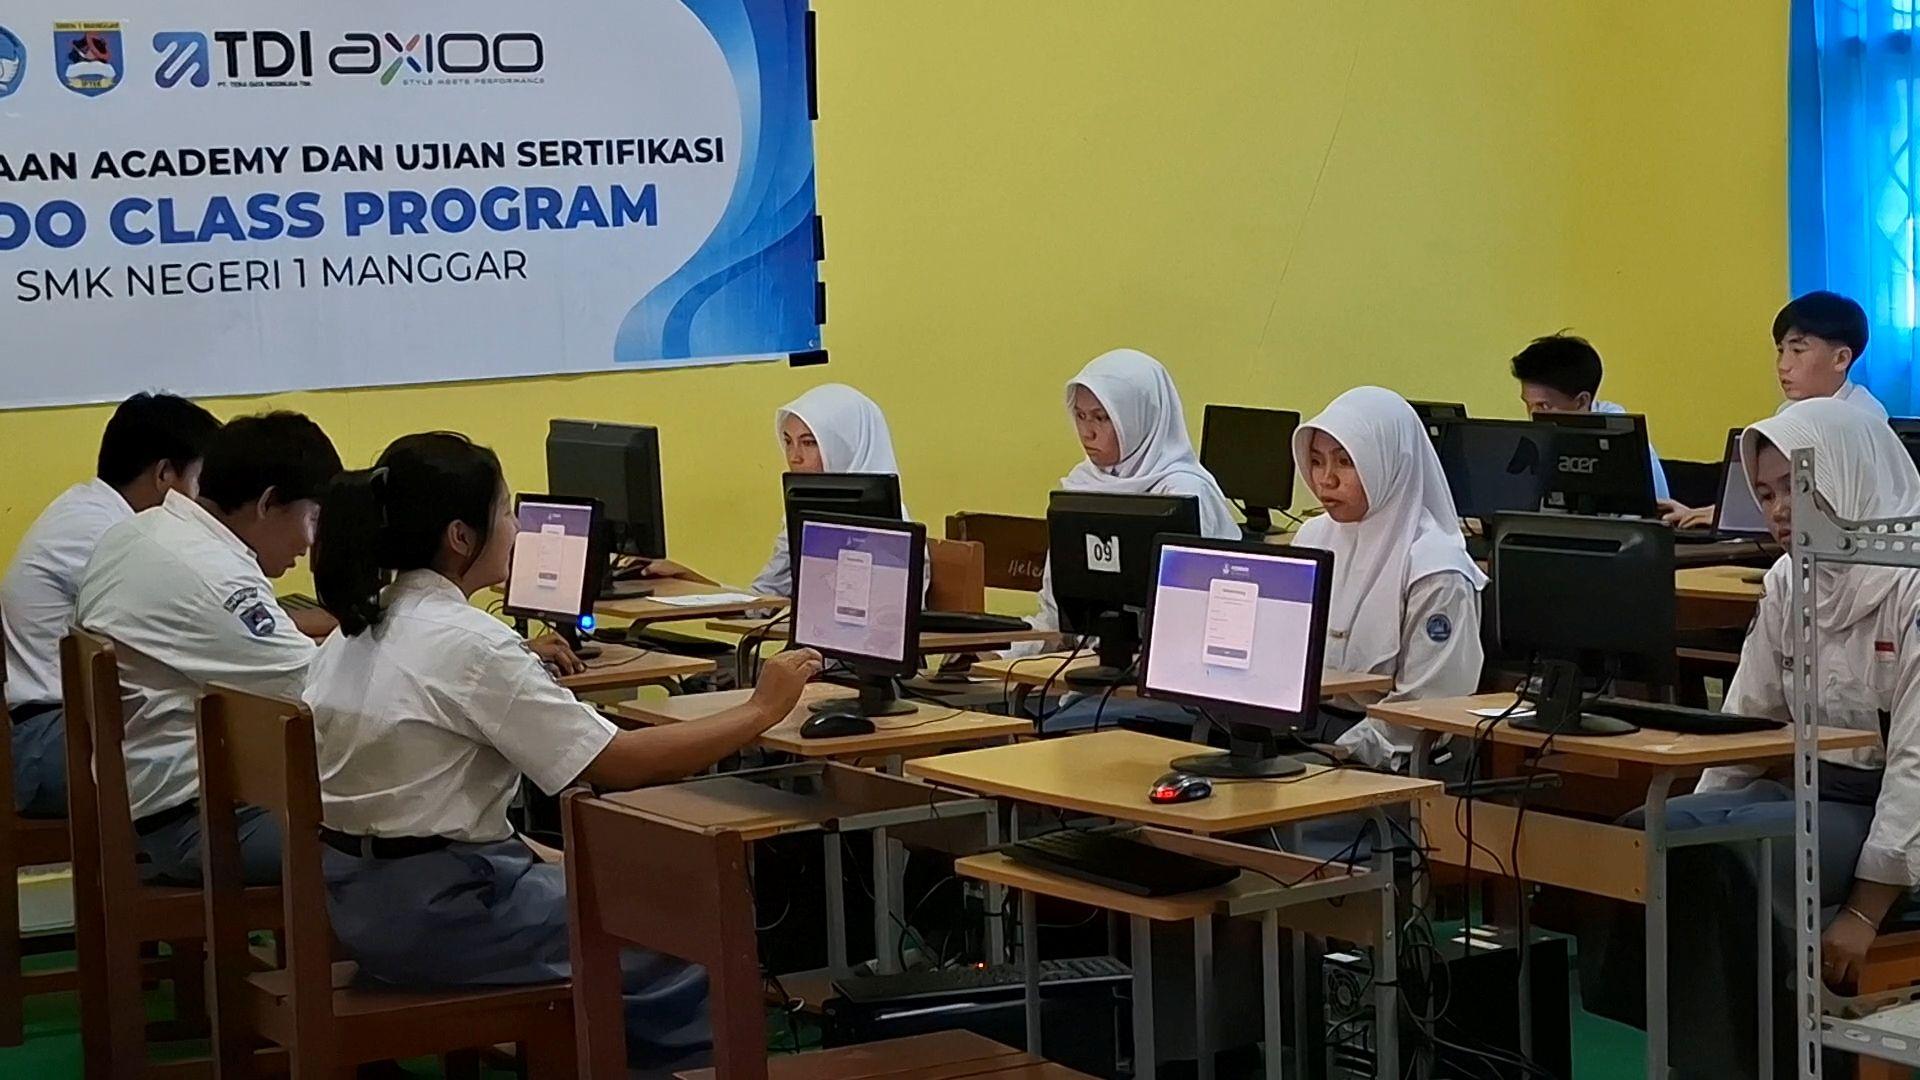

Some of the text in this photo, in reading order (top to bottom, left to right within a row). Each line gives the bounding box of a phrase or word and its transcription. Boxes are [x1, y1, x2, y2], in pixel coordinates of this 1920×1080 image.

[214, 31, 312, 78] TDI
[91, 146, 290, 180] ACADEMY
[302, 144, 384, 173] DAN
[395, 141, 506, 171] UJIAN
[516, 137, 725, 168] SERTIFIKASI
[109, 192, 325, 246] CLASS
[344, 183, 658, 237] PROGRAM
[16, 249, 528, 302] SMK NEGERI 1 MANGGAR
[1558, 456, 1599, 474] acer
[1093, 543, 1112, 562] 09
